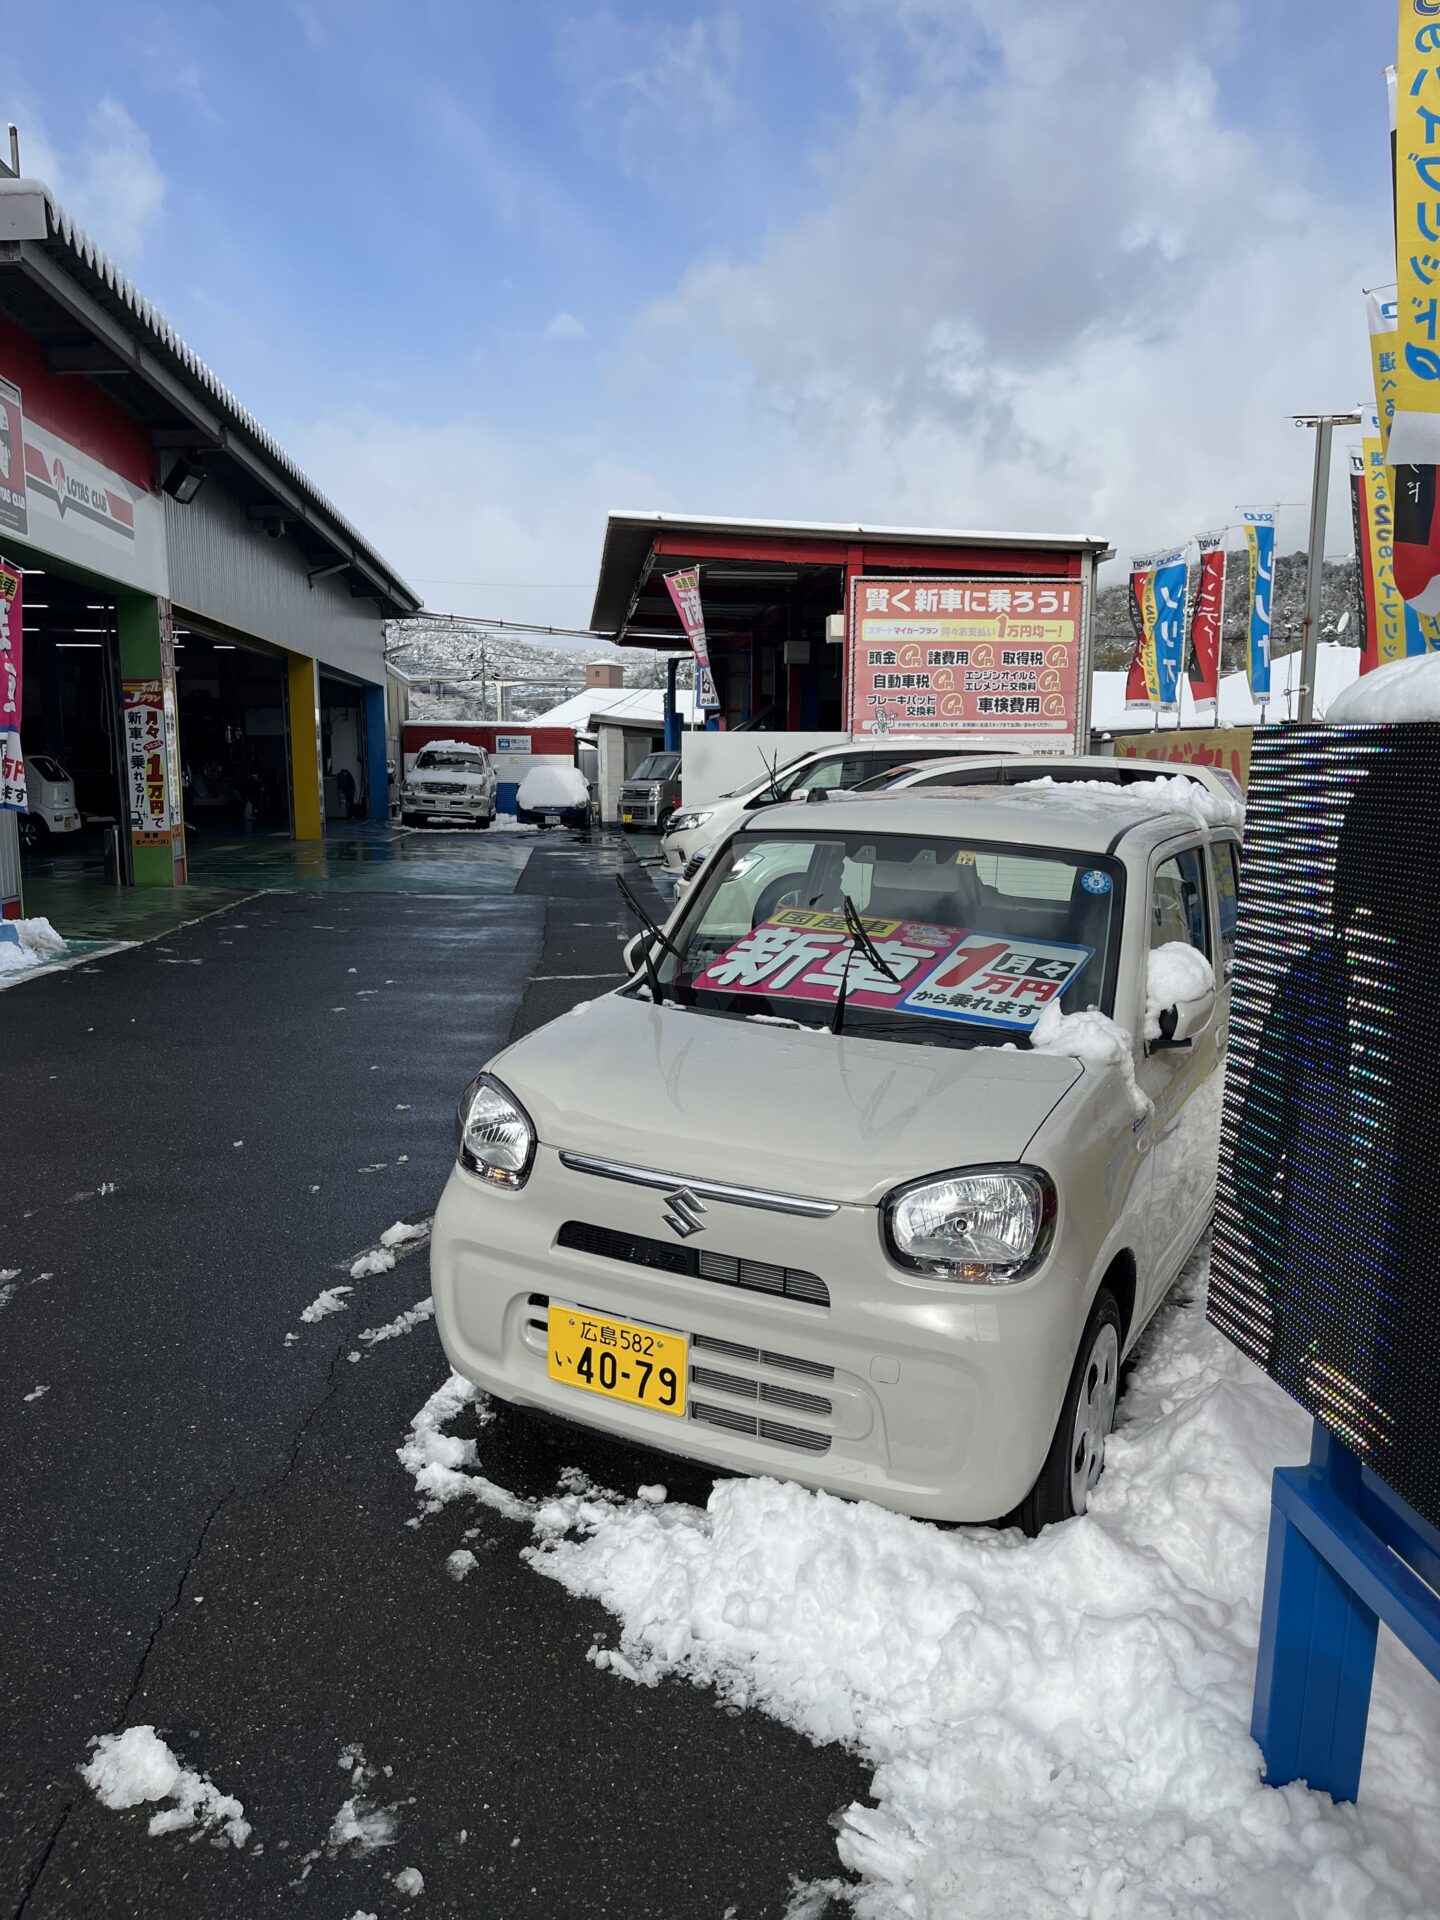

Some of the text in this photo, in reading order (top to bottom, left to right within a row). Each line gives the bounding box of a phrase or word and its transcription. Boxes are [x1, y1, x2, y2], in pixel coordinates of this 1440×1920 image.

[66, 476, 107, 513] LOTAS CLUB
[865, 588, 1071, 613] 賢く新車に乗ろう!
[868, 651, 897, 665] 頭金
[927, 651, 969, 665] 諸費用
[1002, 651, 1044, 666] 取得税
[873, 673, 930, 689] 自動車税
[977, 697, 1041, 713] 車検費用
[707, 927, 937, 998] 新車
[997, 954, 1071, 979] 月々
[912, 990, 1043, 1018] から乗れます
[576, 1346, 677, 1406] 40-79
